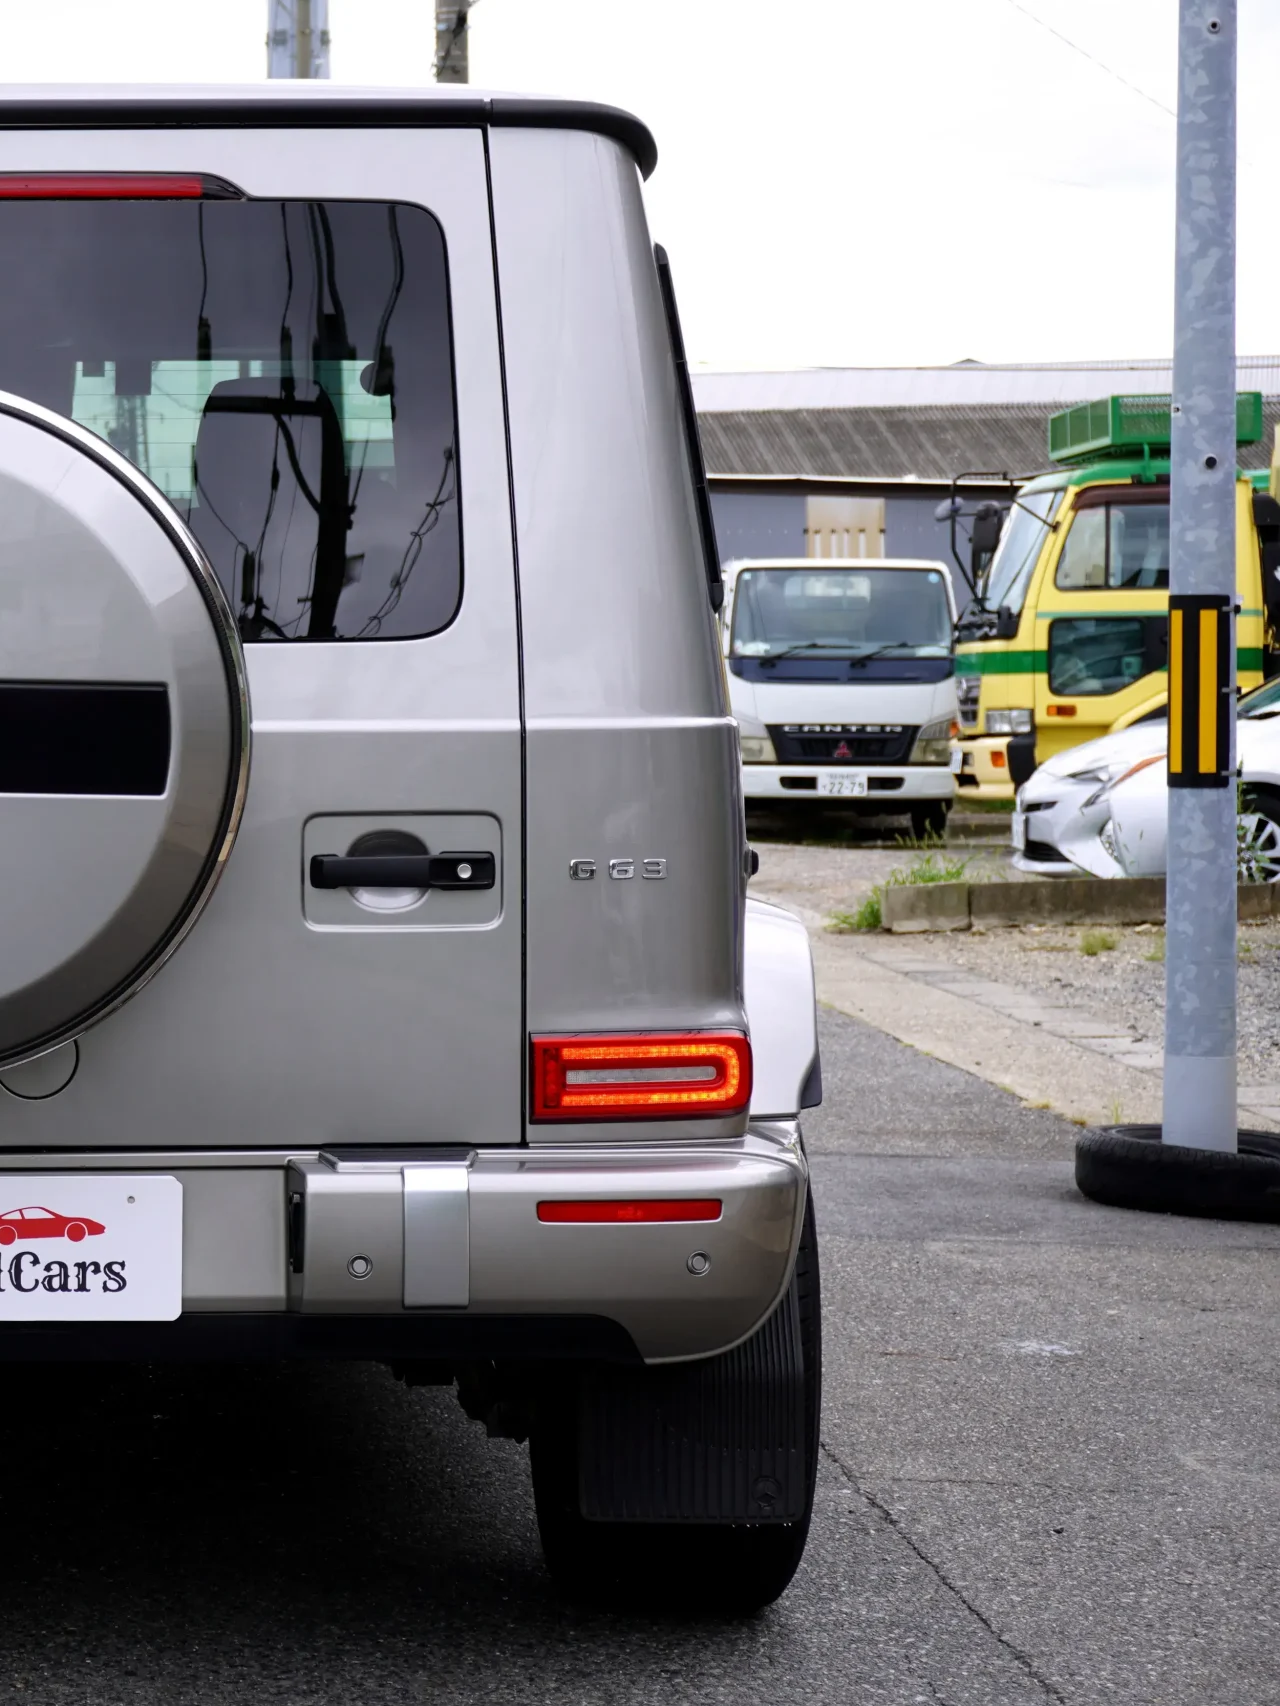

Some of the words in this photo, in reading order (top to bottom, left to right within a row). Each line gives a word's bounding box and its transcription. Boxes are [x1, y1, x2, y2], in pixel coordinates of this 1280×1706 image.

[783, 724, 903, 733] CANTER
[570, 859, 597, 881] G
[609, 858, 668, 880] 63
